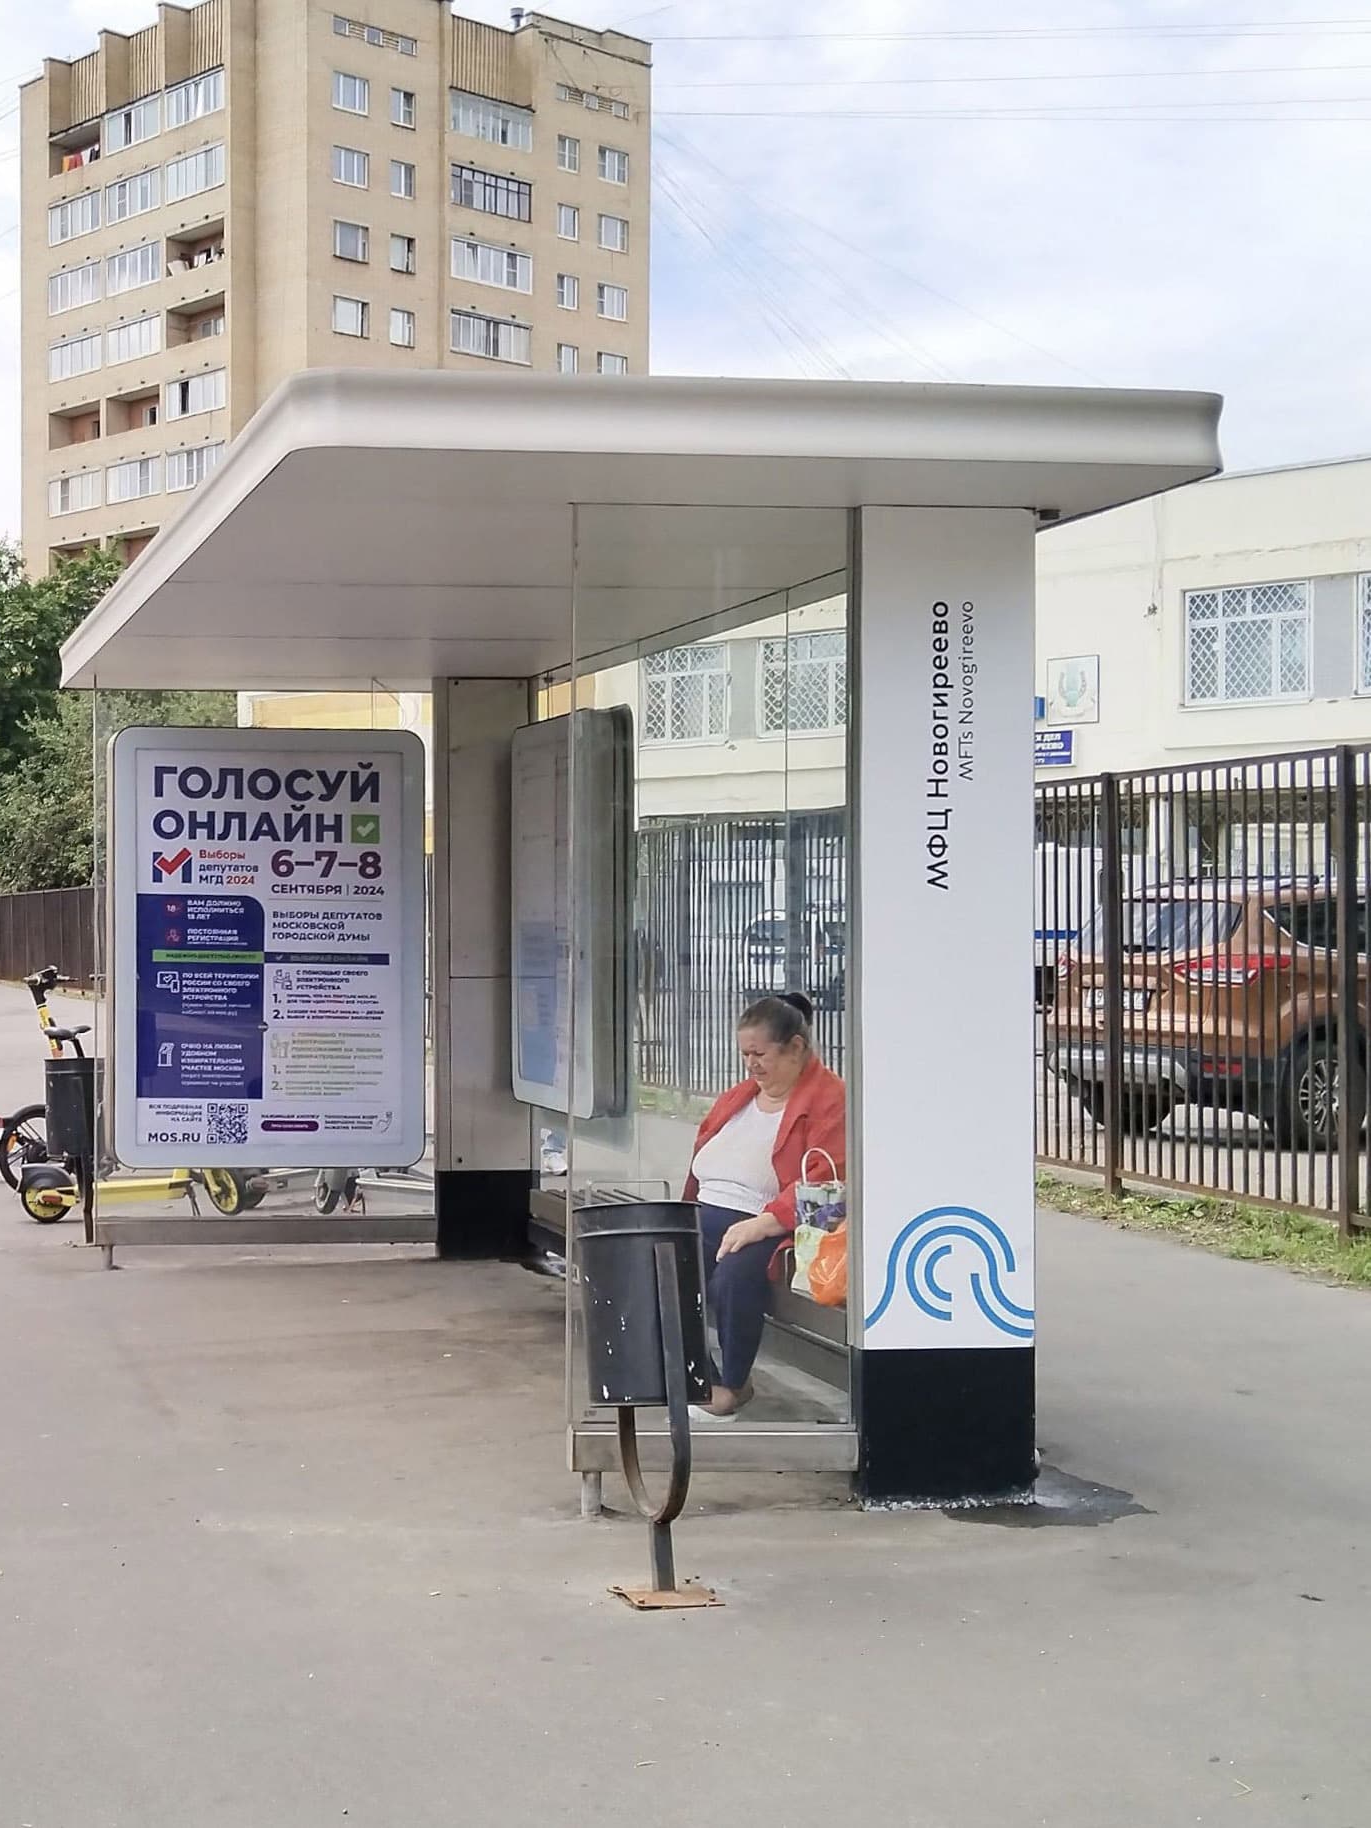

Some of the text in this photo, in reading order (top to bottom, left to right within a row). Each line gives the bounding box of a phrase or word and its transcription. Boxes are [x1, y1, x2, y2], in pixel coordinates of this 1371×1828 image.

[958, 601, 978, 781] MFTs Novogireevo
[926, 601, 954, 890] МФЦ Новогиреево
[153, 761, 380, 803] ГОЛОСУЙ
[152, 804, 343, 844] ОНЛАЙН
[199, 849, 246, 860] Выборы
[198, 864, 259, 874] депутатов
[199, 875, 255, 885] МГД 2024
[271, 884, 385, 896] СЕНТЯБРЯ 2024
[187, 906, 245, 914] ИСПОЛНИТЬСЯ
[272, 911, 383, 920] ВЫБОРЫ ДЕПУТАТОВ
[272, 921, 345, 930] МОСКОВСКОЙ
[272, 932, 371, 942] ГОРОДСКОЙ ДУМЫ
[148, 1132, 201, 1143] MOS.RU
